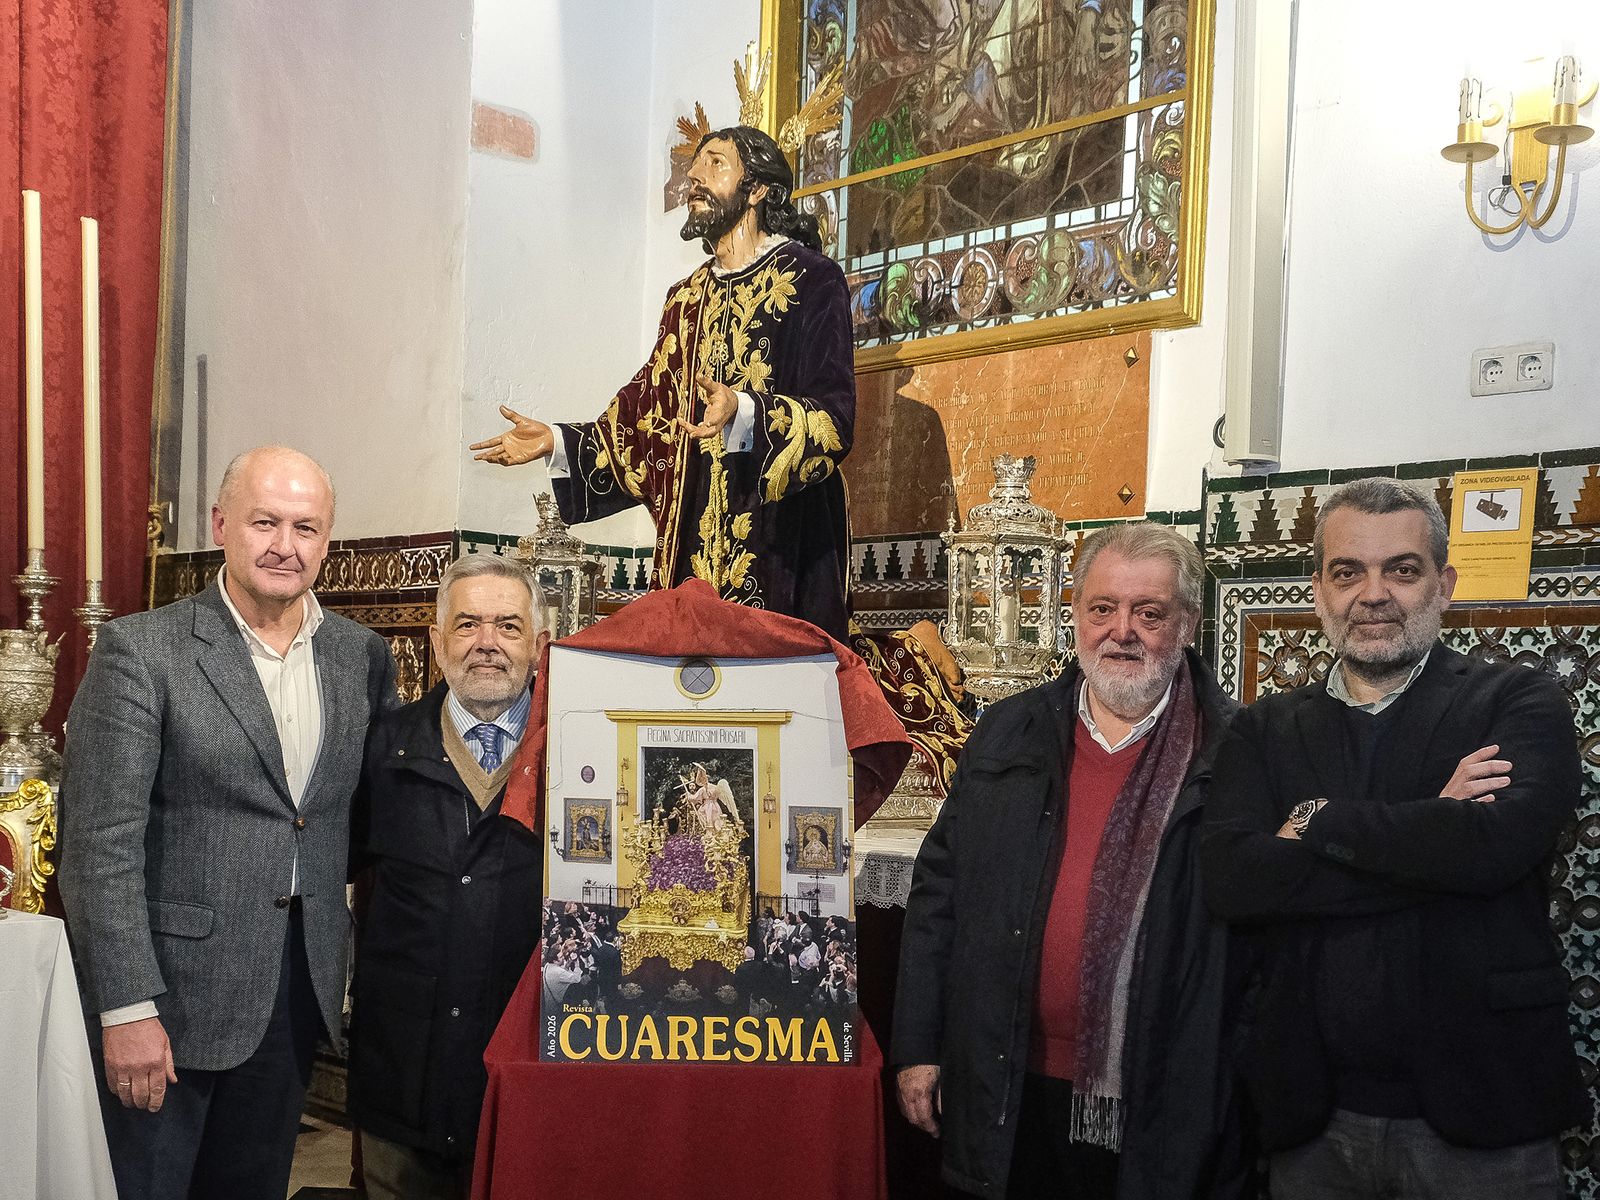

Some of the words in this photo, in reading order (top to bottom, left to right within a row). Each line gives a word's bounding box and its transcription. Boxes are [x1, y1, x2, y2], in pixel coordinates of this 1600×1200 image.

[1480, 475, 1531, 484] VIDEOVIGILADA
[647, 727, 671, 742] REGINA
[673, 728, 717, 743] SACRATISSIMI
[563, 1003, 593, 1013] Revista
[547, 1015, 557, 1037] 2026
[843, 1021, 853, 1033] de
[559, 1013, 840, 1063] CUARESMA
[547, 1039, 556, 1058] Año
[843, 1034, 853, 1063] Sevilla
